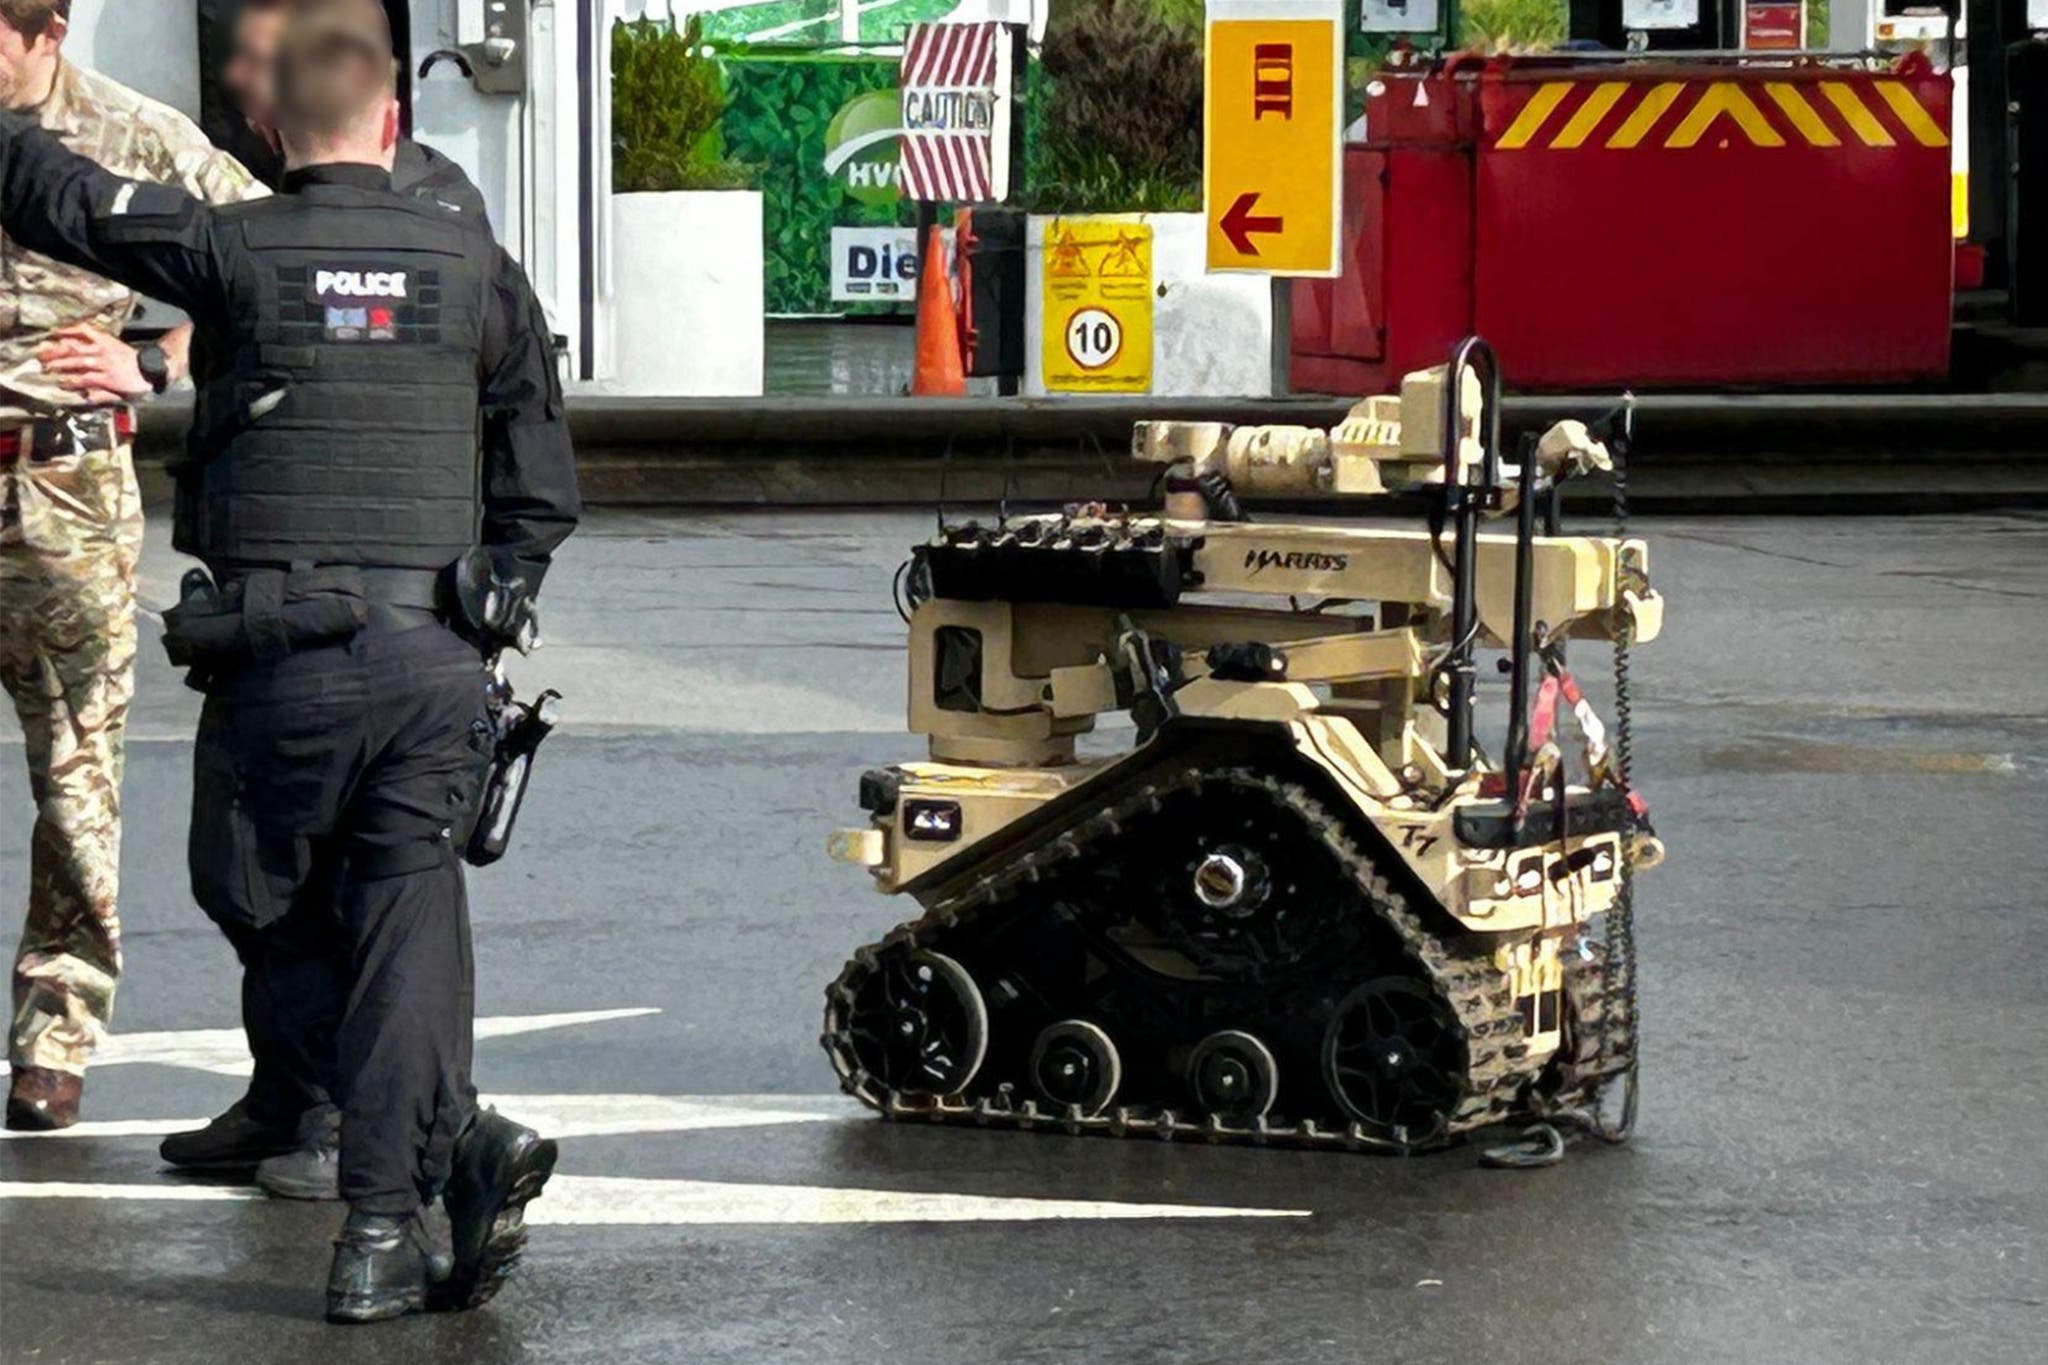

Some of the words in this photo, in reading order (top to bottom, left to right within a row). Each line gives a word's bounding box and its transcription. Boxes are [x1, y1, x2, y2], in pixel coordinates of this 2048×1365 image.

[906, 91, 989, 130] CAUTION
[316, 269, 407, 297] POLICE
[1076, 321, 1112, 354] 10
